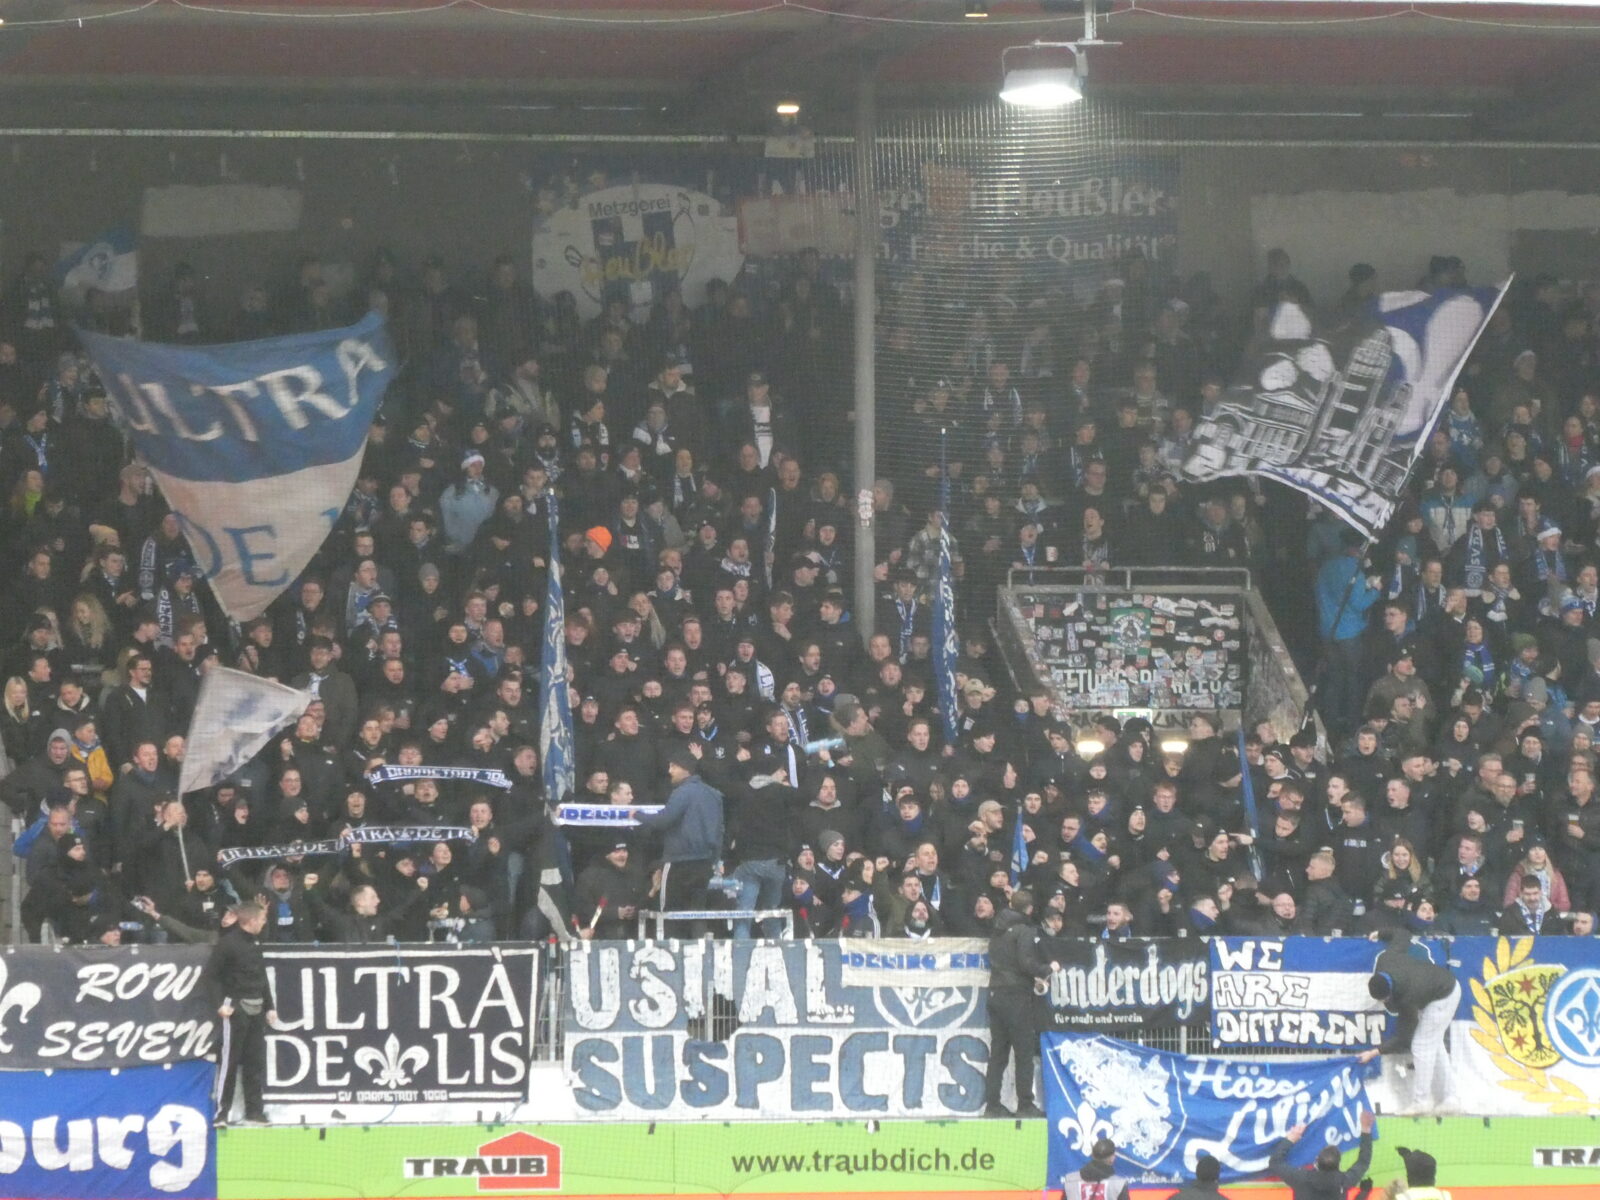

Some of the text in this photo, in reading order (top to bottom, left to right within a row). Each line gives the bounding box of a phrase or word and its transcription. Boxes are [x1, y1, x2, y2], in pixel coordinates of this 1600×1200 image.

[1215, 936, 1284, 971] WE
[75, 961, 203, 1003] ROW
[1215, 974, 1311, 1009] ARE
[37, 1019, 214, 1062] SEVEN
[265, 1033, 527, 1087] DE LIS
[571, 1030, 991, 1113] SUSPECTS
[405, 1157, 546, 1176] TRAUB
[731, 1147, 996, 1174] www.traubdich.de
